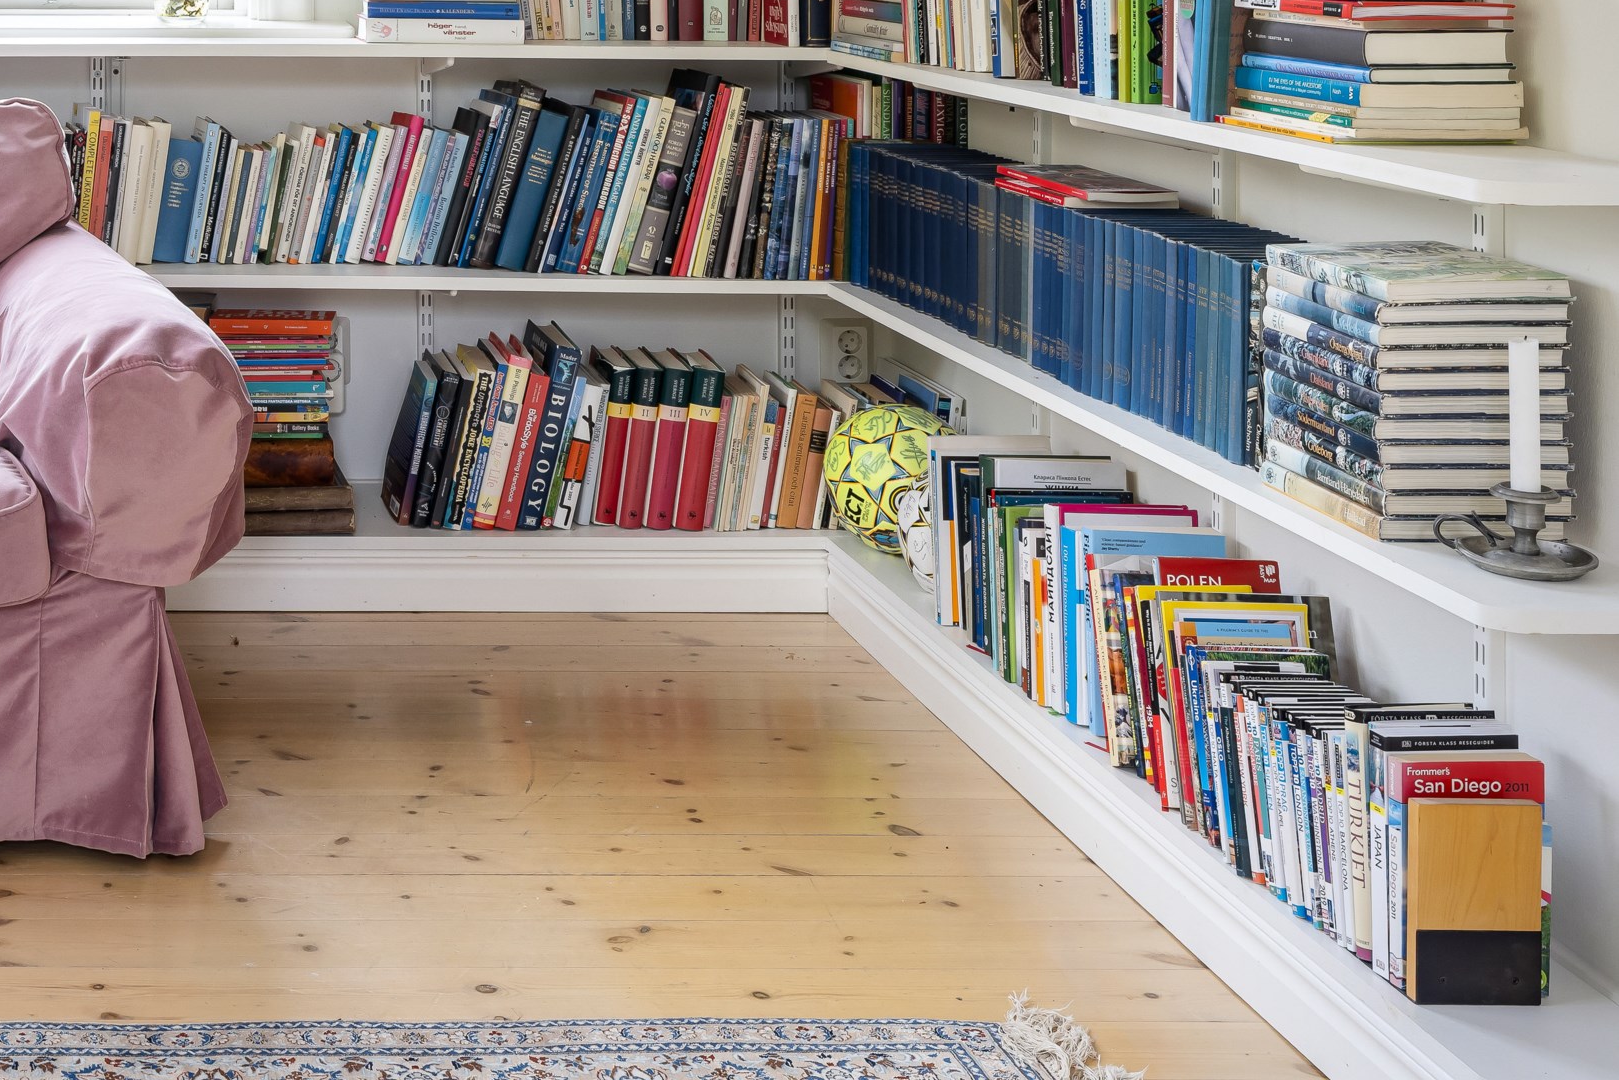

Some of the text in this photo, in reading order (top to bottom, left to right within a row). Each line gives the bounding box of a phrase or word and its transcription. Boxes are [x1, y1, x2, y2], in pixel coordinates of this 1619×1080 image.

[427, 22, 453, 30] höger
[1077, 14, 1086, 74] ADRIAN ROOM
[463, 128, 484, 188] TRANSFORMATION
[492, 110, 532, 219] THE ENGLISH LANGUAGE
[597, 133, 625, 210] Addiction WORKBOOK
[722, 142, 738, 197] BORGARSKOLAS
[81, 132, 98, 224] COMPLETE UKRAINIAN
[284, 166, 305, 242] FÖRSVAR ANNORLUNDA
[203, 216, 214, 249] Medkänsla
[559, 353, 577, 362] Mader
[508, 368, 522, 401] Bill Phillips
[1310, 372, 1333, 391] Dalsland
[292, 424, 306, 432] Gallery
[700, 408, 711, 417] IV
[1245, 407, 1253, 452] Stockholm
[1297, 410, 1335, 437] Södermanland
[506, 407, 537, 502] BurdaStyle Sewing Handbook
[527, 393, 566, 512] BIOLOGY
[762, 437, 771, 460] turkish
[792, 411, 811, 475] Latinska sentenser
[1307, 440, 1333, 461] Göteborg
[455, 428, 478, 502] JOKE ENCYCLOPEDIA
[1344, 507, 1366, 526] Halland
[1167, 575, 1222, 586] POLEN
[1146, 705, 1154, 728] 1984
[1190, 680, 1200, 721] Ukraine
[1216, 736, 1224, 761] OSLO
[1254, 741, 1262, 772] PARIS
[1407, 766, 1451, 777] Frommer's
[1414, 777, 1530, 796] San Diego 2011
[1293, 787, 1303, 832] LONDON
[1316, 779, 1326, 824] MADRID
[1348, 779, 1366, 889] TURKIET
[1374, 824, 1383, 870] JAPAN
[1390, 834, 1398, 857] San
[1340, 831, 1348, 891] BARCELONA
[1390, 860, 1398, 899] Diego
